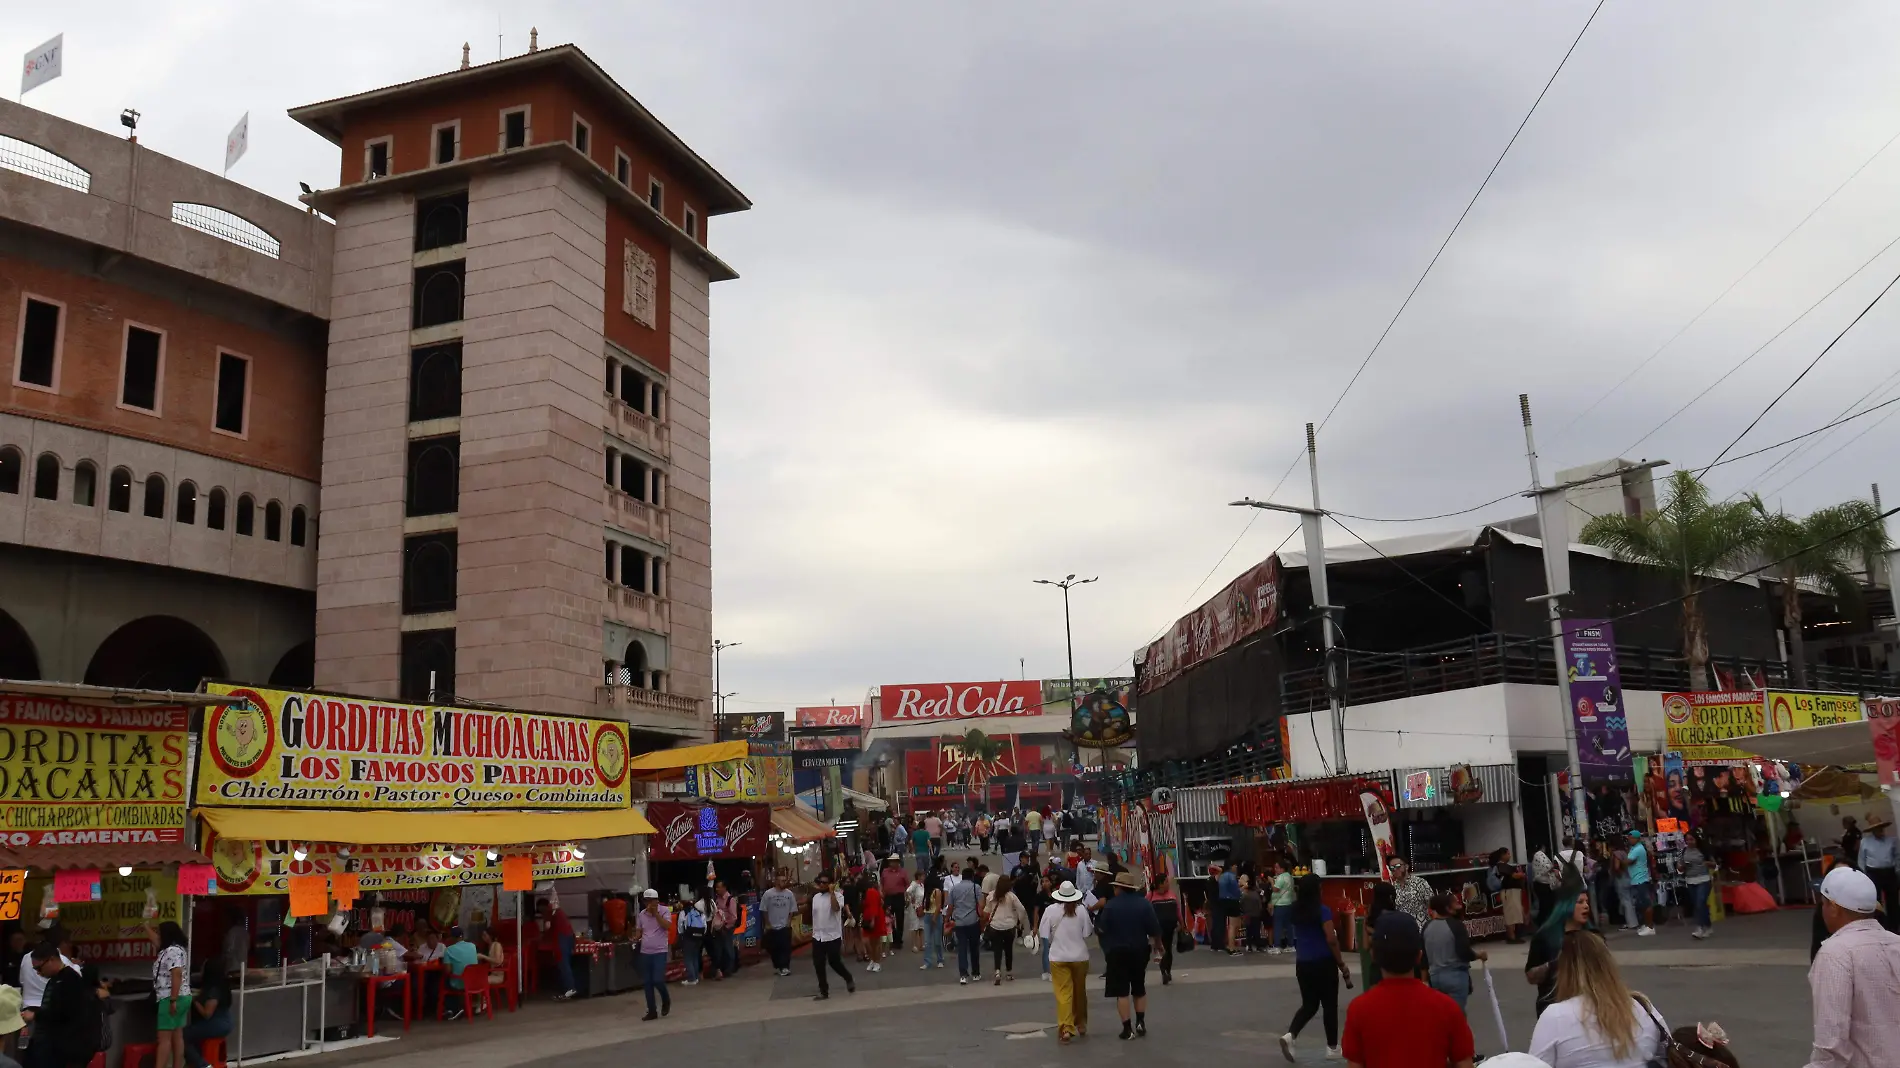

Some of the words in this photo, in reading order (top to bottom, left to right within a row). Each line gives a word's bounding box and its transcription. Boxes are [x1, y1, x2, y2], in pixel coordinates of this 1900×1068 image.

[893, 685, 957, 718] Red
[956, 684, 1026, 716] Cola
[1694, 694, 1704, 704] LOS
[1706, 693, 1731, 703] FAMOSOS
[1732, 692, 1757, 702] PARADOS
[1795, 696, 1812, 711] Los
[1816, 697, 1857, 712] Famosos
[15, 701, 97, 724] FAMOSOS
[102, 709, 172, 727] PARADOS
[825, 708, 857, 725] Red
[1692, 705, 1764, 726] GORDITAS
[1812, 713, 1846, 726] Parados
[281, 696, 425, 756] GORDITAS
[433, 710, 590, 764] MICHOACANAS
[280, 755, 340, 781] LOS
[350, 759, 475, 785] FAMOSOS
[483, 764, 596, 788] PARADOS
[220, 780, 360, 801] Chicharrón
[368, 787, 441, 803] Pastor
[452, 788, 514, 807] Queso
[525, 787, 625, 804] Combinadas
[5, 806, 91, 828] CHICHARRON
[106, 806, 183, 826] COMBINADAS
[38, 831, 158, 845] ARMENTA
[269, 858, 332, 875] LOS
[394, 873, 450, 885] Pastor
